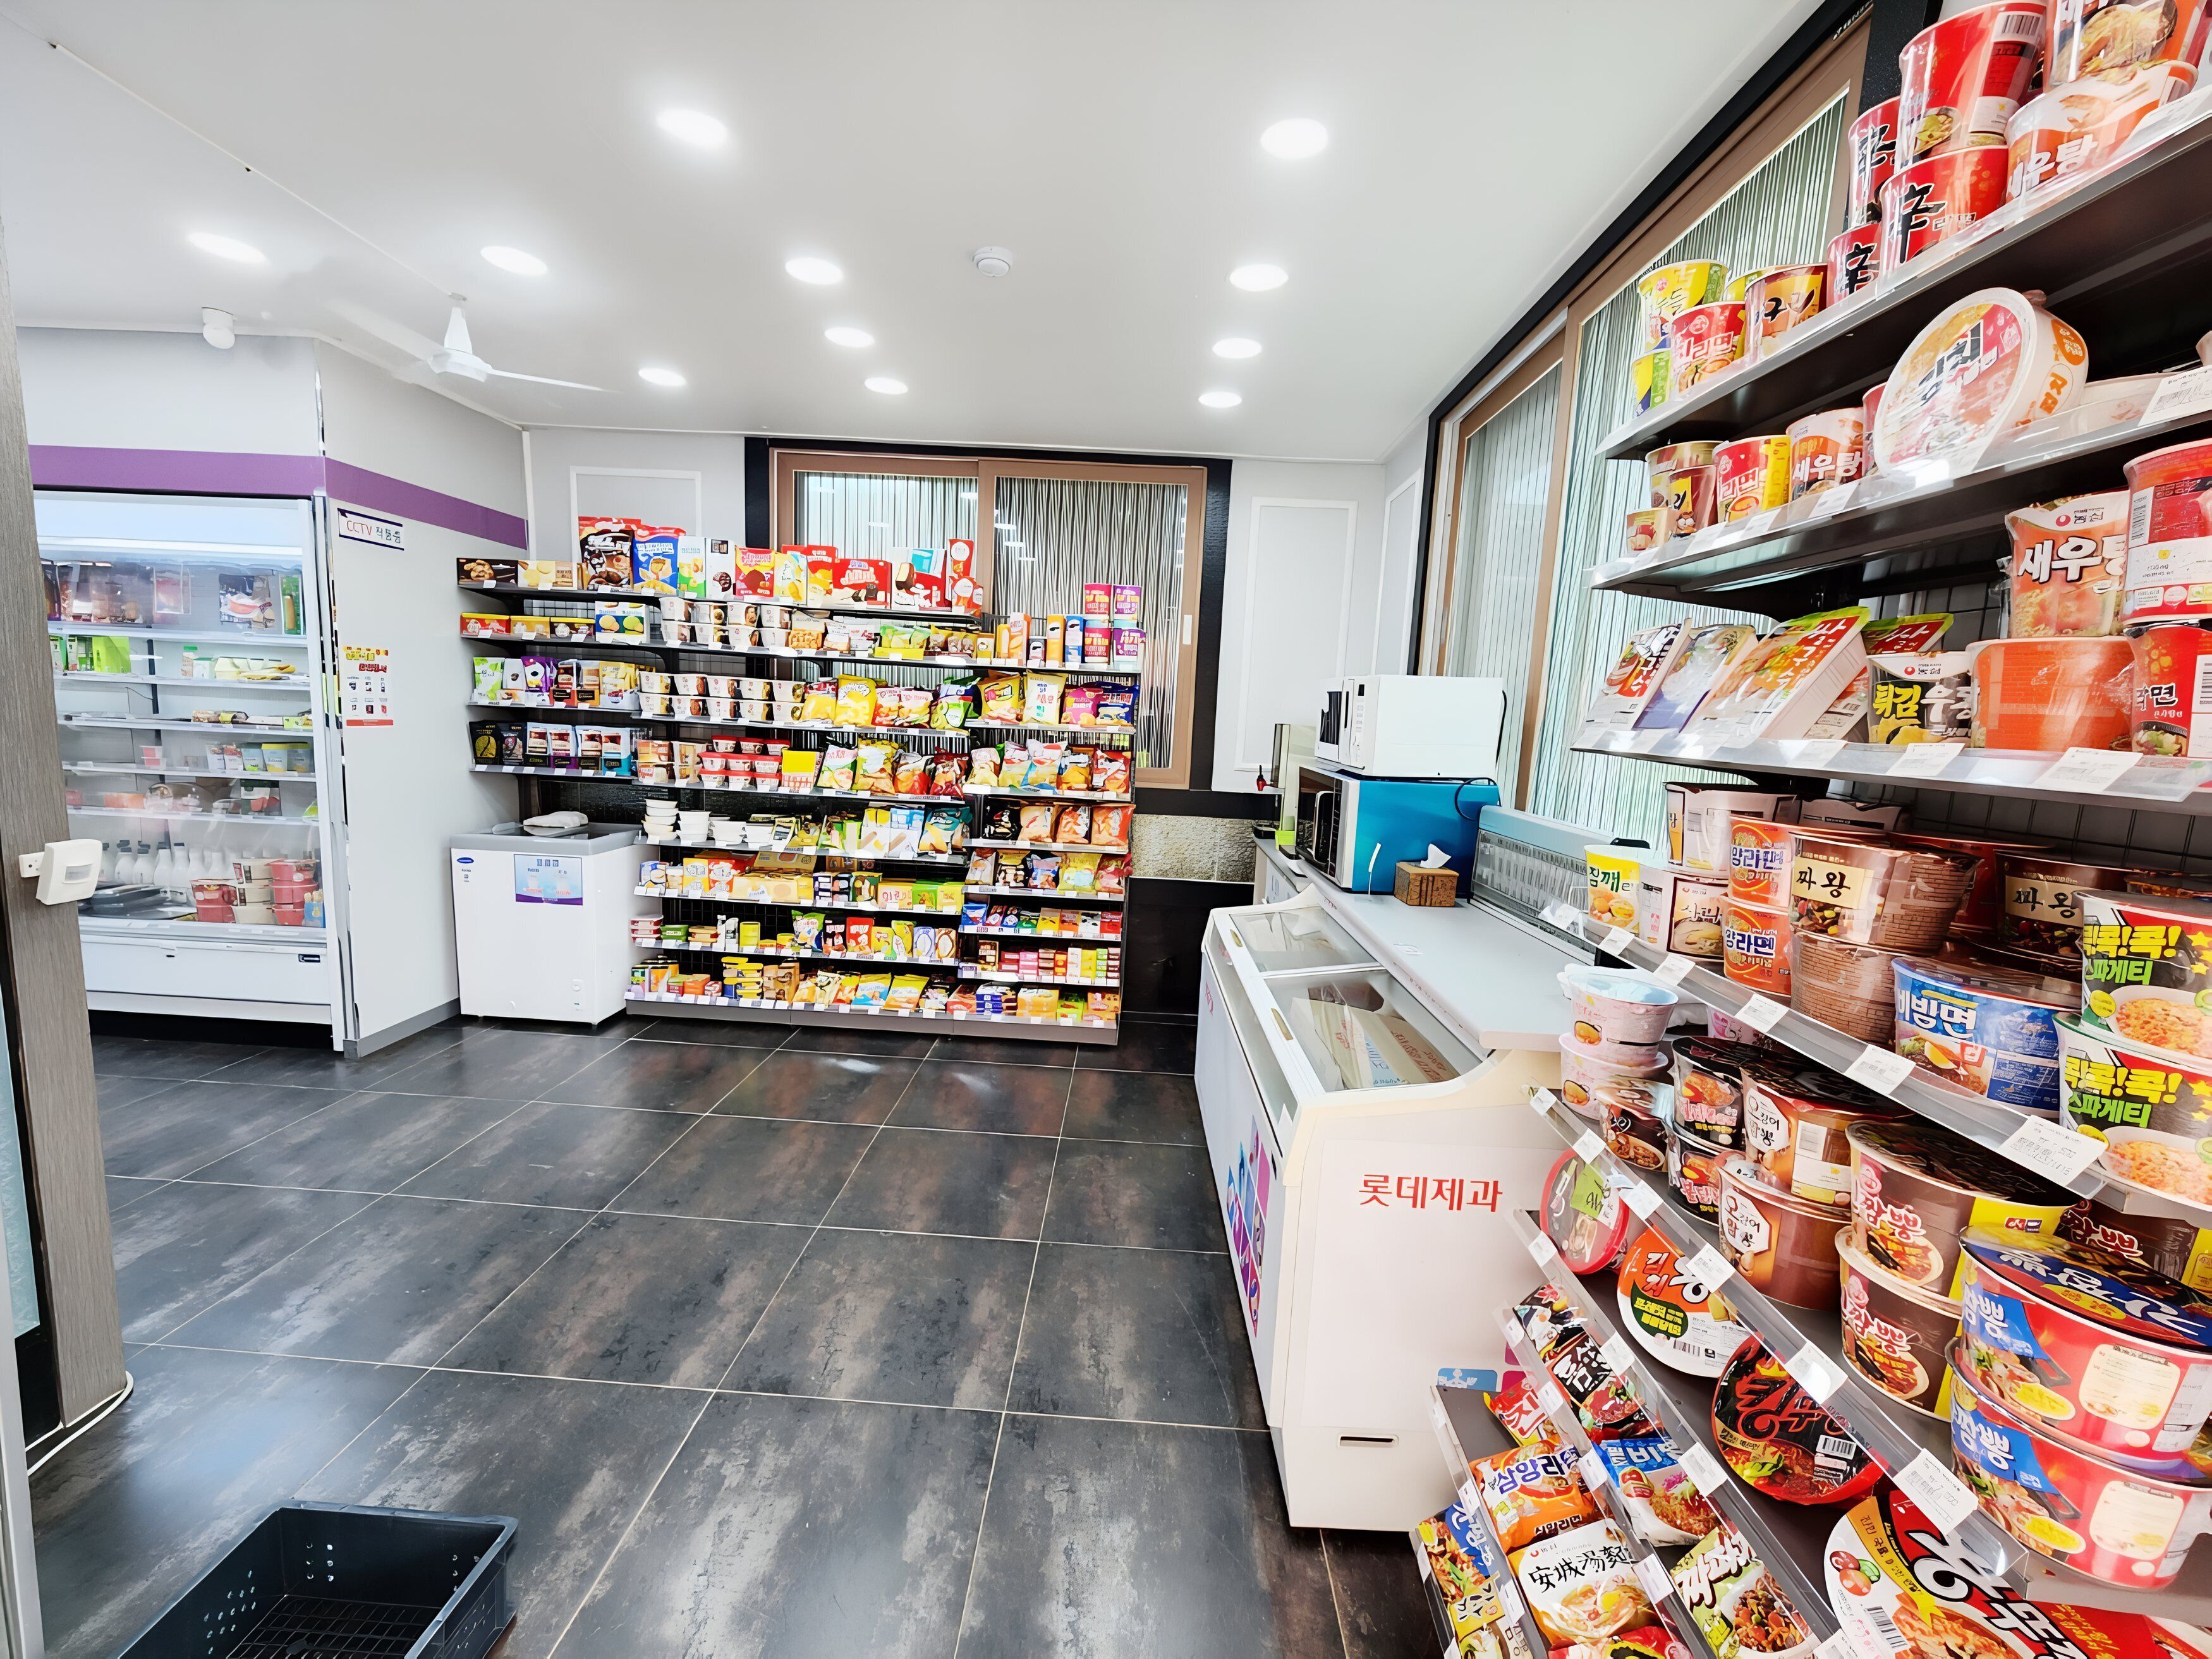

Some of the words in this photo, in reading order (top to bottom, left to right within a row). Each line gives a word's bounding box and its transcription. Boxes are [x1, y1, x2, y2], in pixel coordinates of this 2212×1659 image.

[1793, 451, 1864, 482] 새우탕
[1719, 468, 1759, 502] 라면
[346, 520, 372, 535] CCTV
[2134, 683, 2179, 711] 라면
[1796, 866, 1851, 899] 짜왕
[2012, 886, 2082, 919] 짜왕
[1725, 928, 1775, 957] 양라면
[1359, 1174, 1504, 1213] 롯데제과
[1641, 1251, 1671, 1297] 김치
[1964, 1284, 2009, 1339] 짬뽕
[1954, 1402, 2015, 1471] 짬뽕
